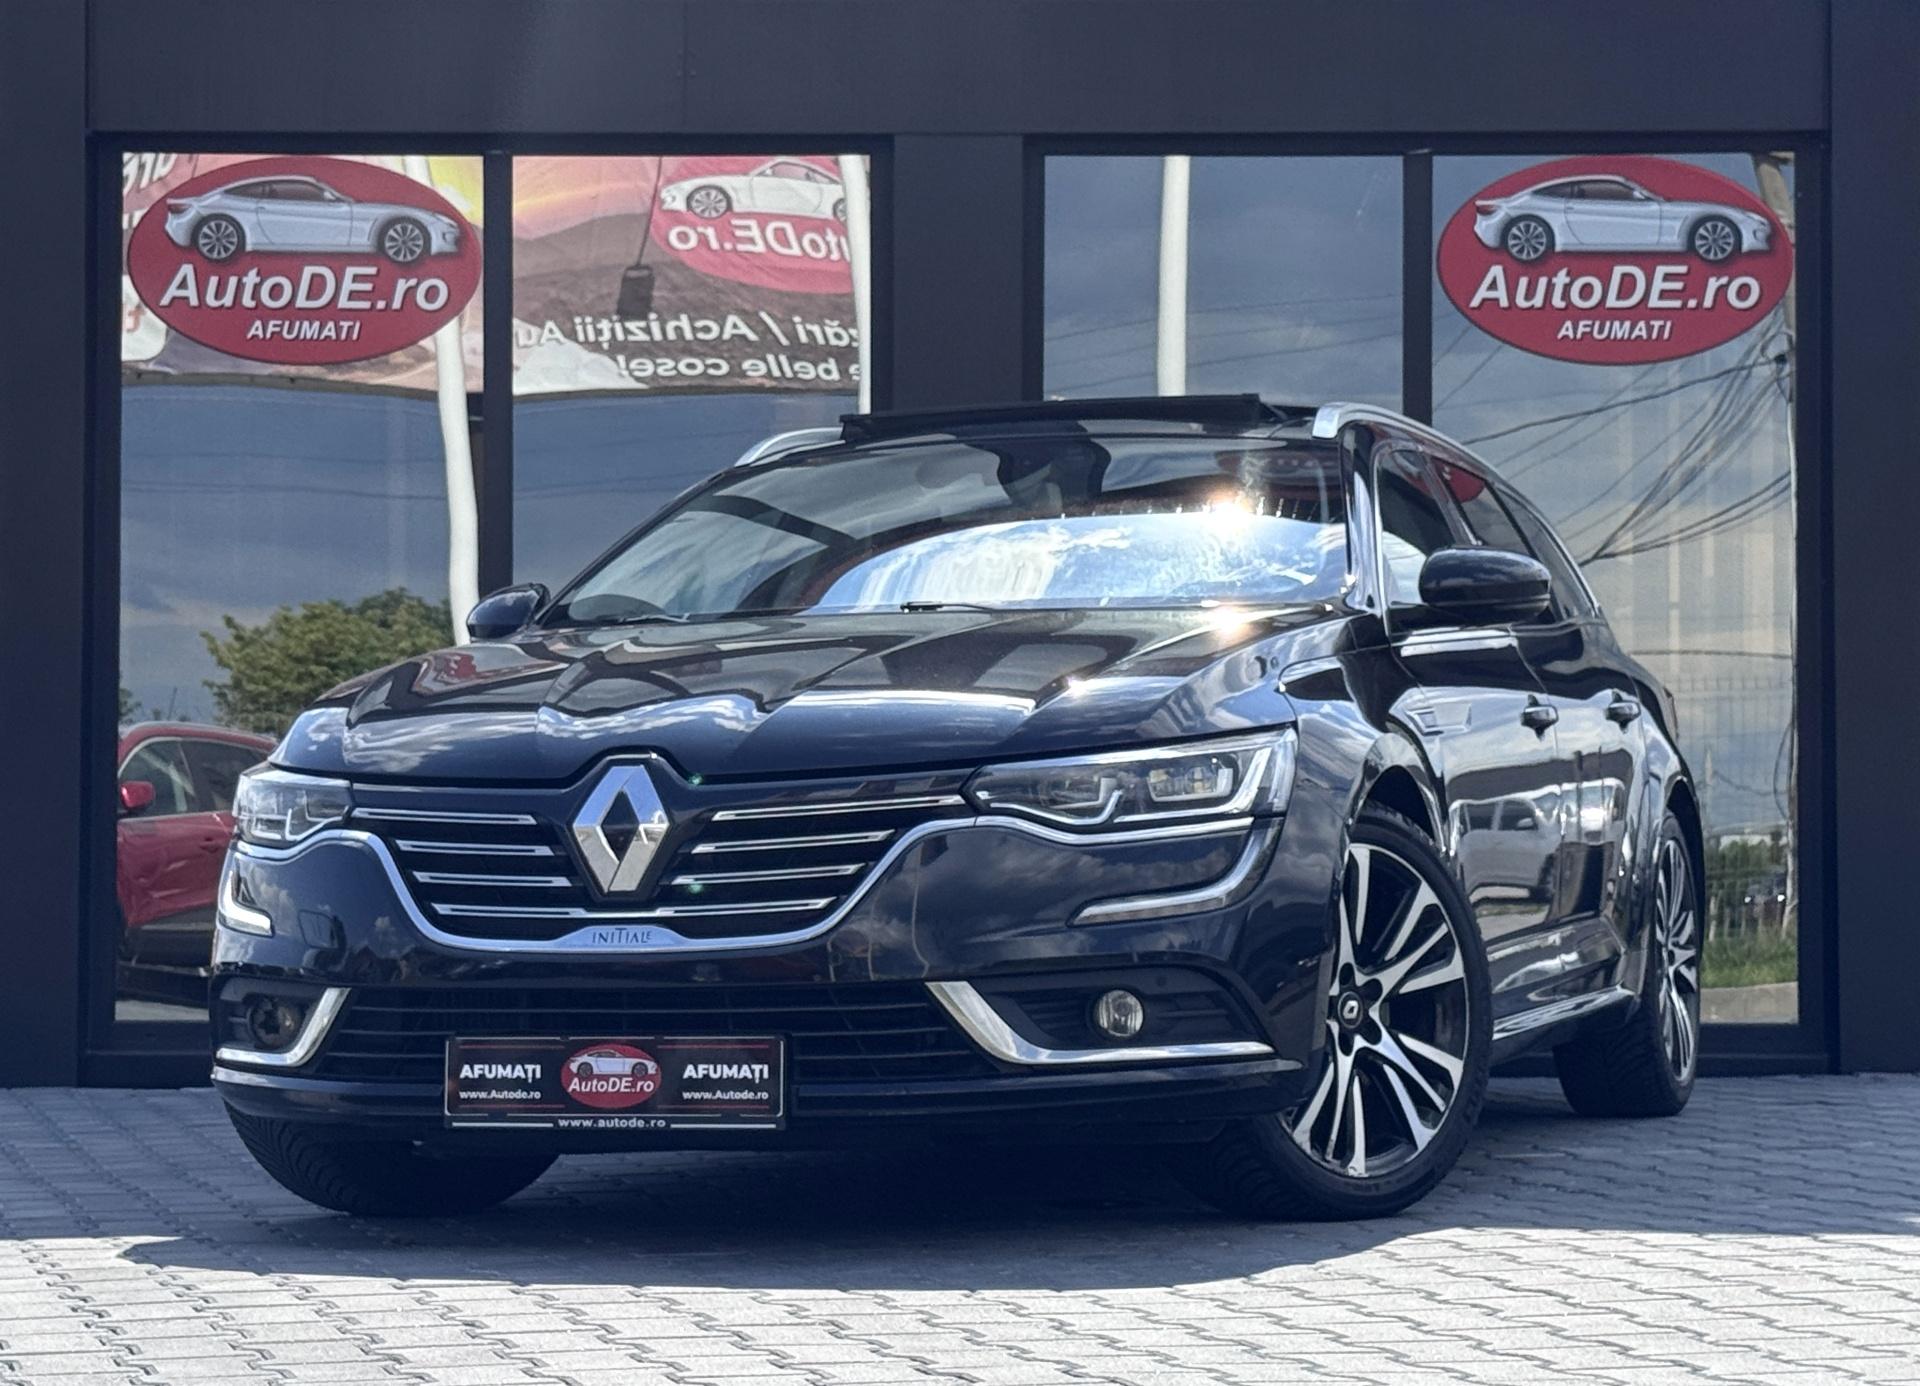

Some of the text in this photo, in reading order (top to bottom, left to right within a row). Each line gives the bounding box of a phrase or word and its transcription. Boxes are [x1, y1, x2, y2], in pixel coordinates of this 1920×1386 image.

[160, 264, 449, 311] AutoDE.ro
[1469, 265, 1761, 310] AutoDE.ro
[247, 320, 361, 341] AFUMATI
[1557, 320, 1672, 341] AFUMATI
[459, 1089, 541, 1100] www.Autode.ro
[567, 1077, 655, 1094] AutoDE.ro
[682, 1089, 769, 1101] www.Autode.ro
[558, 1117, 666, 1129] www.autode.ro
